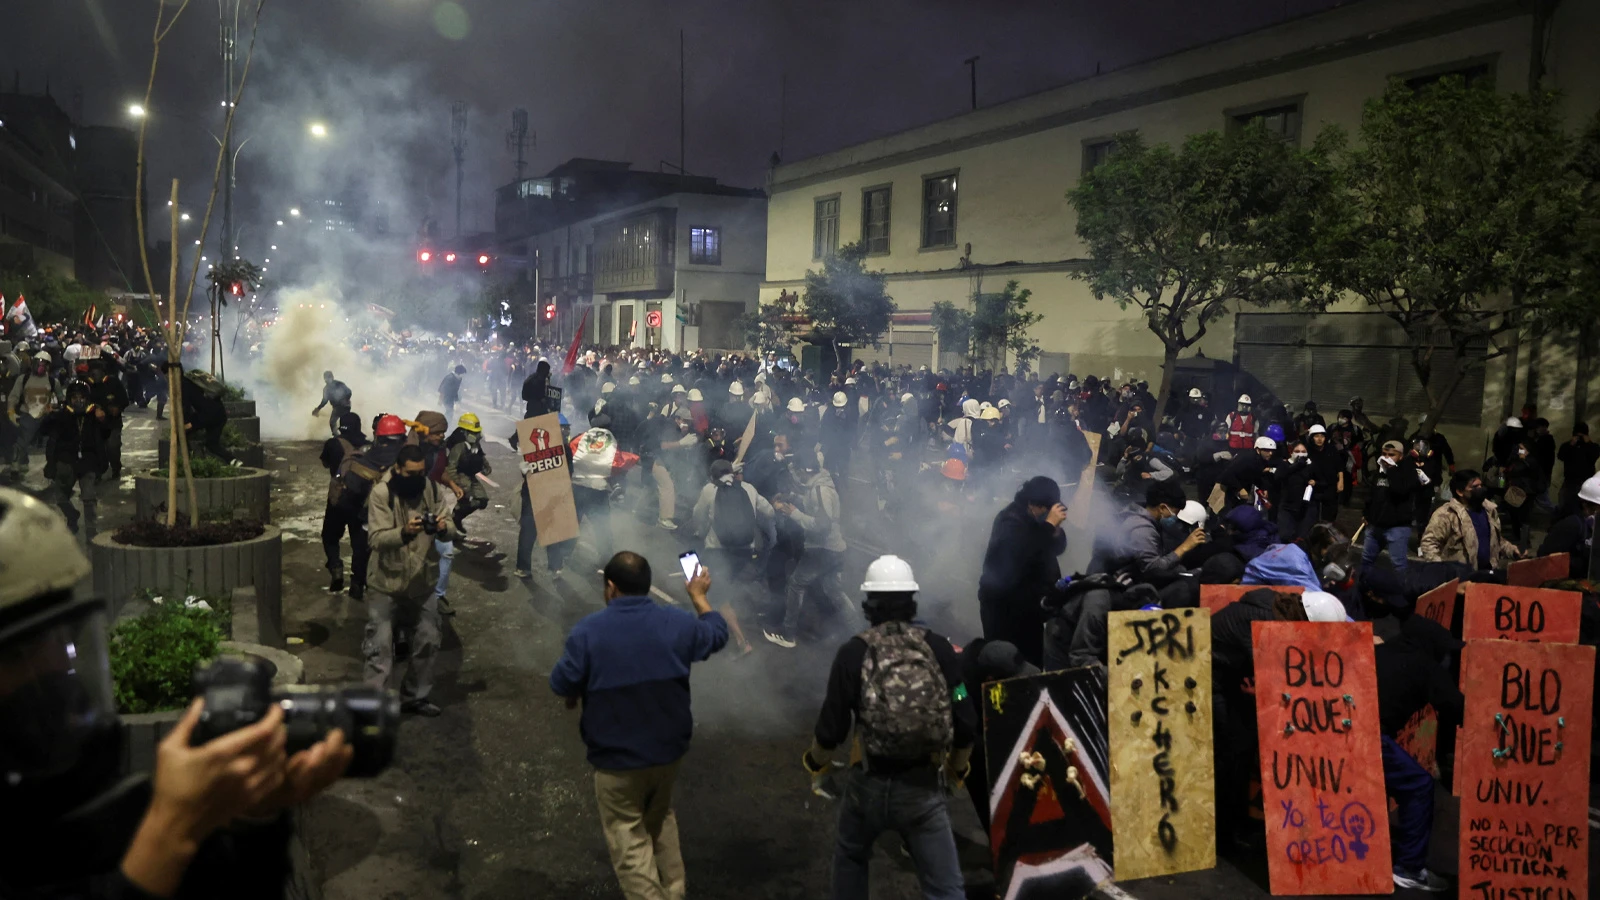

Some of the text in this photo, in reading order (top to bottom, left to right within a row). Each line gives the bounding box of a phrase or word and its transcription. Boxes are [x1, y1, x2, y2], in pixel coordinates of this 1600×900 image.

[524, 445, 564, 462] RESISTE
[1495, 596, 1545, 633] BLO
[1284, 645, 1344, 688] BLO
[1500, 662, 1562, 715] BLO
[1291, 697, 1346, 735] QUE
[1500, 714, 1556, 766] QUE
[1272, 751, 1352, 794] UNIV.
[1476, 778, 1549, 806] UNIV.
[1470, 818, 1491, 832] NO
[1498, 819, 1509, 832] A
[1515, 820, 1535, 838] LA
[1286, 834, 1347, 865] CREO
